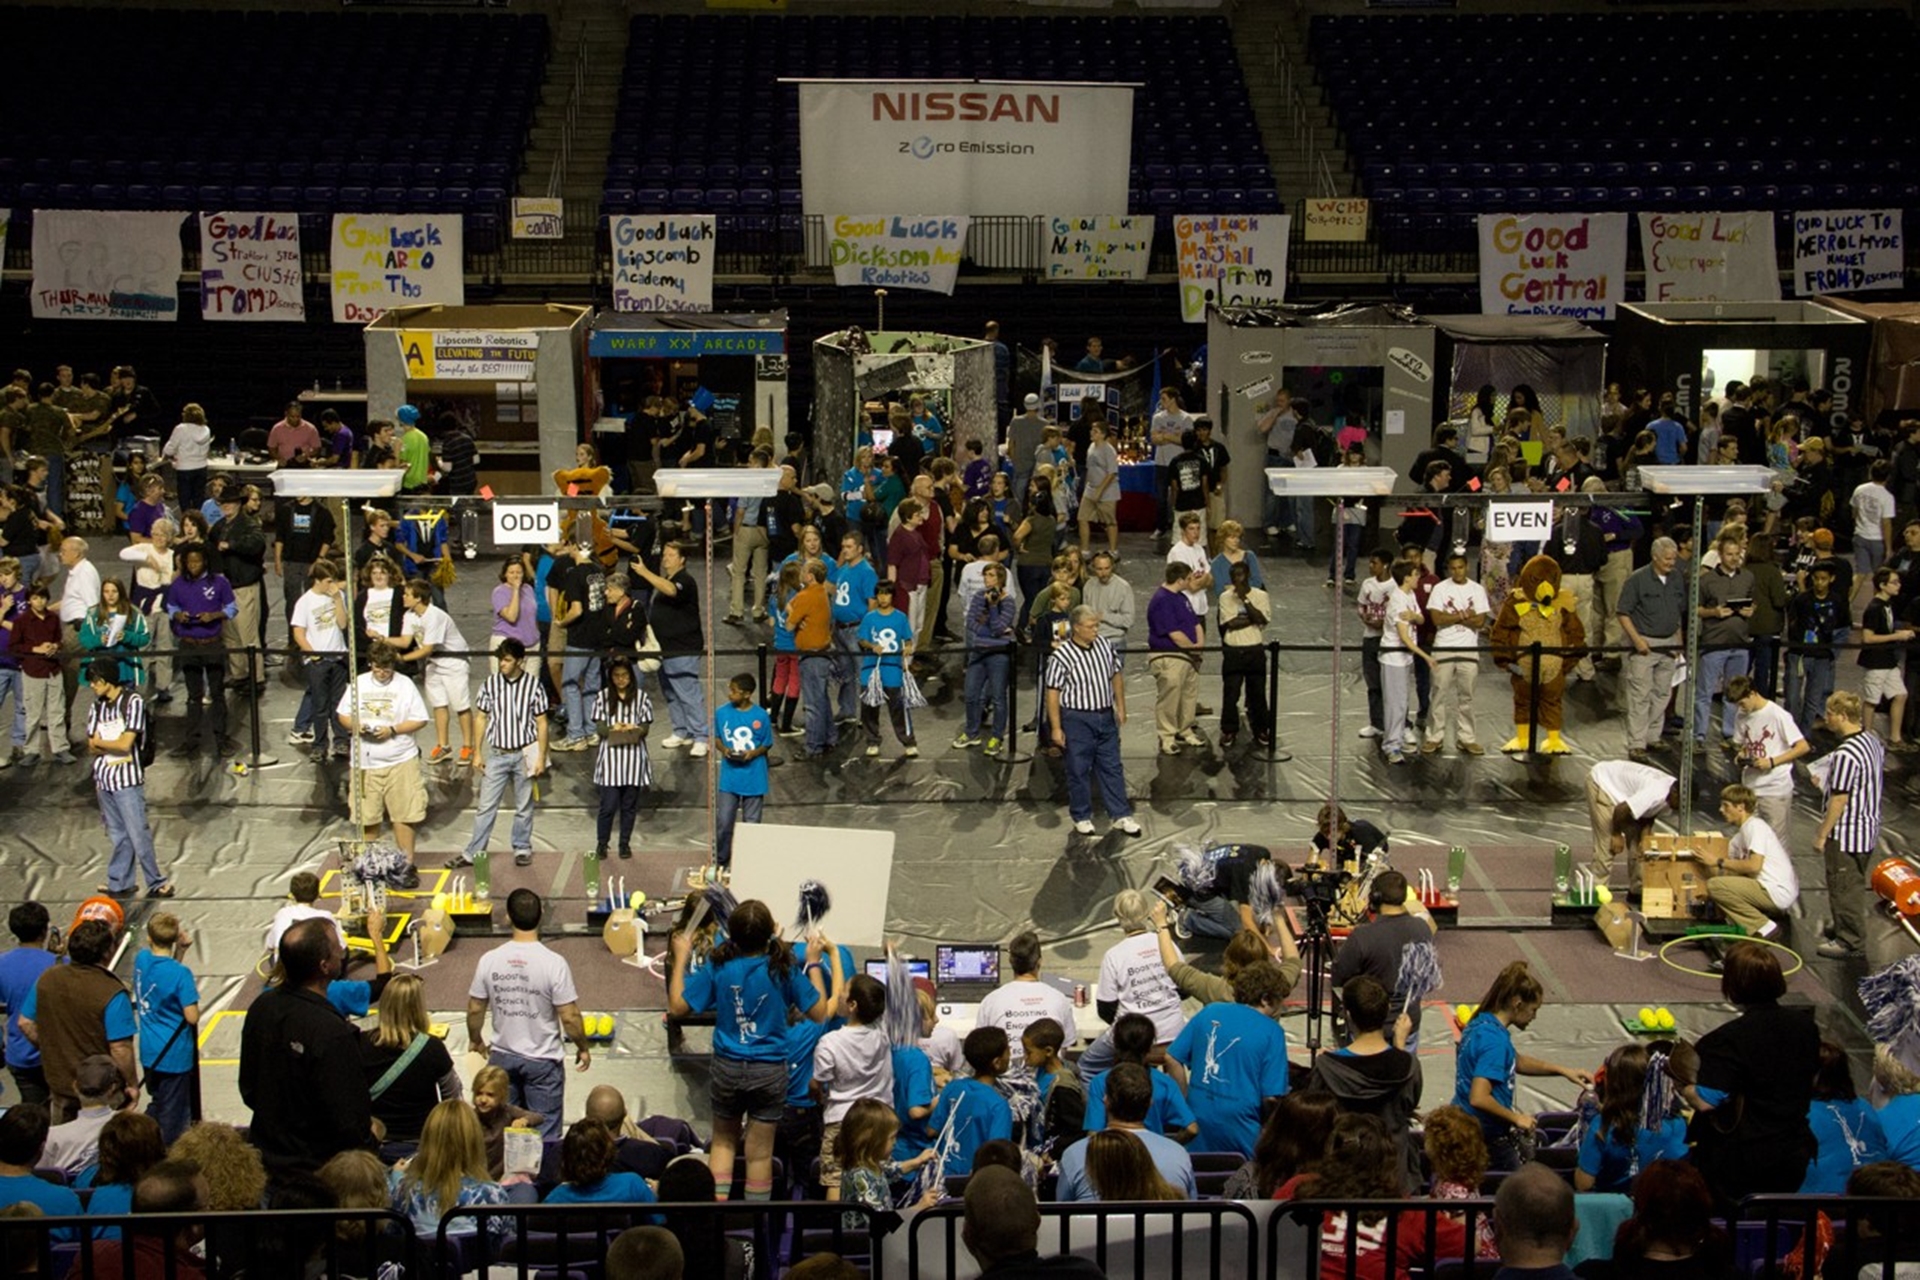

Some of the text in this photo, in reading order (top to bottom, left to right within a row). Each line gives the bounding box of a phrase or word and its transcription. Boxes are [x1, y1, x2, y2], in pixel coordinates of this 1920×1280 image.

[872, 92, 1060, 123] NISSAN
[960, 141, 1034, 155] Emission
[1316, 200, 1367, 214] WCHS
[208, 216, 264, 241] Good
[615, 217, 714, 246] Good Luck
[834, 214, 886, 239] Good
[1176, 217, 1219, 240] Good
[1650, 215, 1704, 241] Good
[1825, 214, 1867, 232] LUCK
[1869, 212, 1892, 230] TO
[1492, 217, 1590, 254] Good
[1859, 233, 1900, 250] HYDE
[617, 245, 701, 270] Lipscomb
[1519, 251, 1570, 270] Luck
[616, 268, 686, 295] Academy
[861, 266, 931, 285] Robotics
[1226, 265, 1273, 287] From
[1499, 272, 1608, 303] Central
[614, 288, 653, 312] From
[436, 334, 528, 346] Lipscomb Robotics
[610, 338, 768, 350] WARP XX ARCADE
[437, 348, 484, 359] ELEVATING
[436, 363, 466, 375] Simply
[467, 363, 479, 373] the
[1061, 387, 1081, 397] TEAM
[501, 513, 552, 531] ODD
[1494, 511, 1548, 528] EVEN
[1005, 1010, 1048, 1019] BOOSTING
